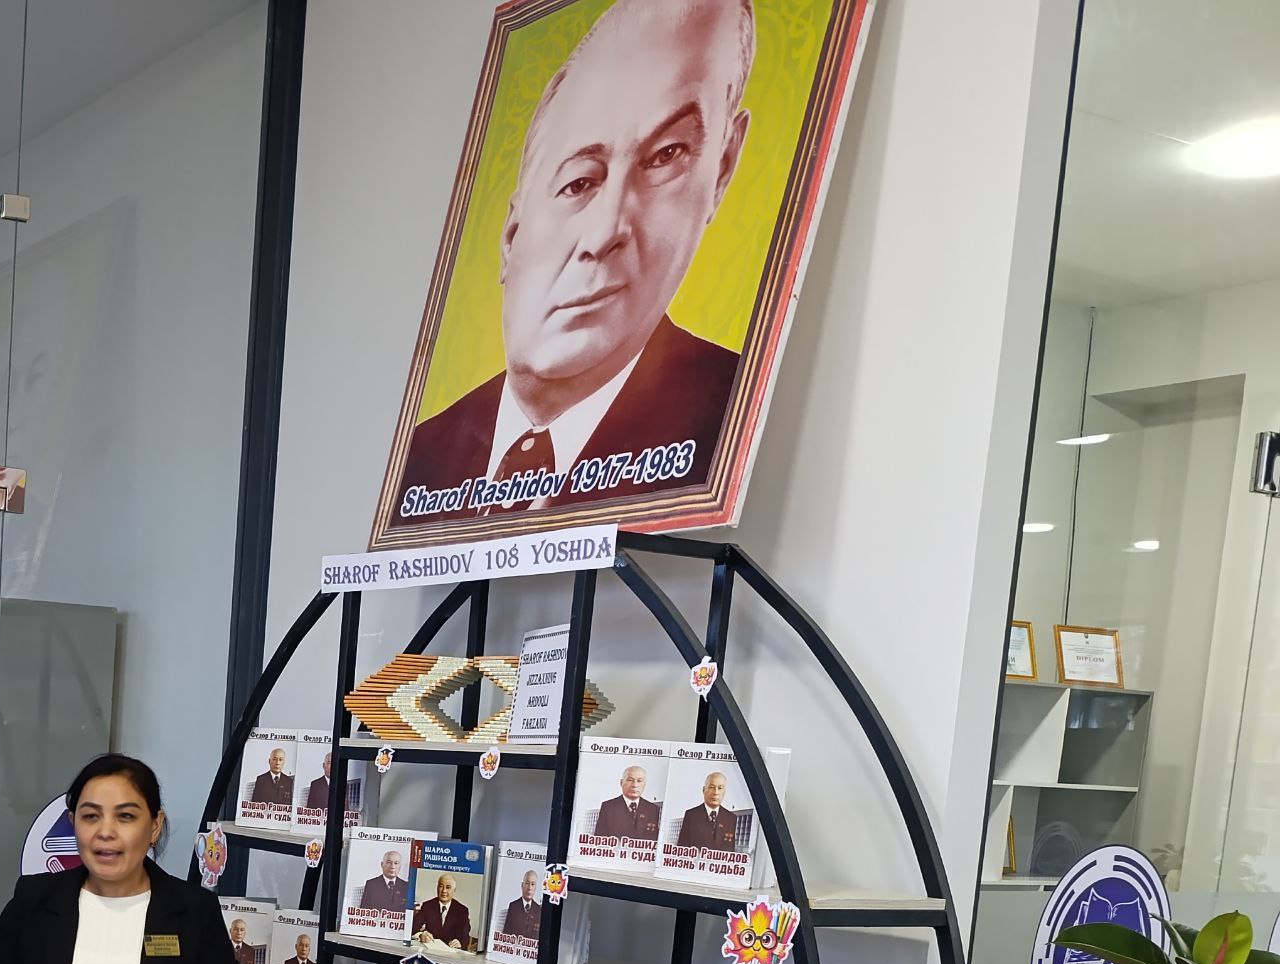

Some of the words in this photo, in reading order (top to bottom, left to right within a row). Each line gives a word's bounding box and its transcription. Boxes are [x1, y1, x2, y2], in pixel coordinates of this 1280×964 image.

[401, 483, 469, 516] Sharof
[473, 470, 567, 507] Rashidov
[571, 441, 695, 493] 1917-1983
[323, 563, 380, 586] SHAROF
[389, 549, 475, 581] RASHIDOV
[485, 543, 520, 571] 108
[531, 536, 612, 565] YOSHDA
[522, 651, 543, 665] SHAROF
[591, 743, 619, 754] Федор
[622, 745, 663, 756] Раззаков
[677, 748, 703, 759] Федор
[241, 801, 266, 811] Шараф
[268, 802, 292, 813] Рашид
[274, 812, 292, 822] судь
[579, 834, 617, 847] Шараф
[622, 837, 657, 851] Рашид
[425, 846, 450, 854] ШАРАФ
[580, 847, 615, 858] жизнь
[620, 850, 627, 859] и
[631, 851, 655, 863] судь
[663, 844, 697, 858] Шараф
[424, 854, 457, 862] РАШИДОВ
[663, 858, 695, 870] жизнь
[699, 862, 706, 871] и
[709, 863, 745, 876] судьба
[347, 907, 378, 919] Шараф
[381, 910, 405, 921] Раши
[348, 918, 376, 928] жизнь
[389, 921, 405, 931] суд
[493, 931, 516, 945] Шараф
